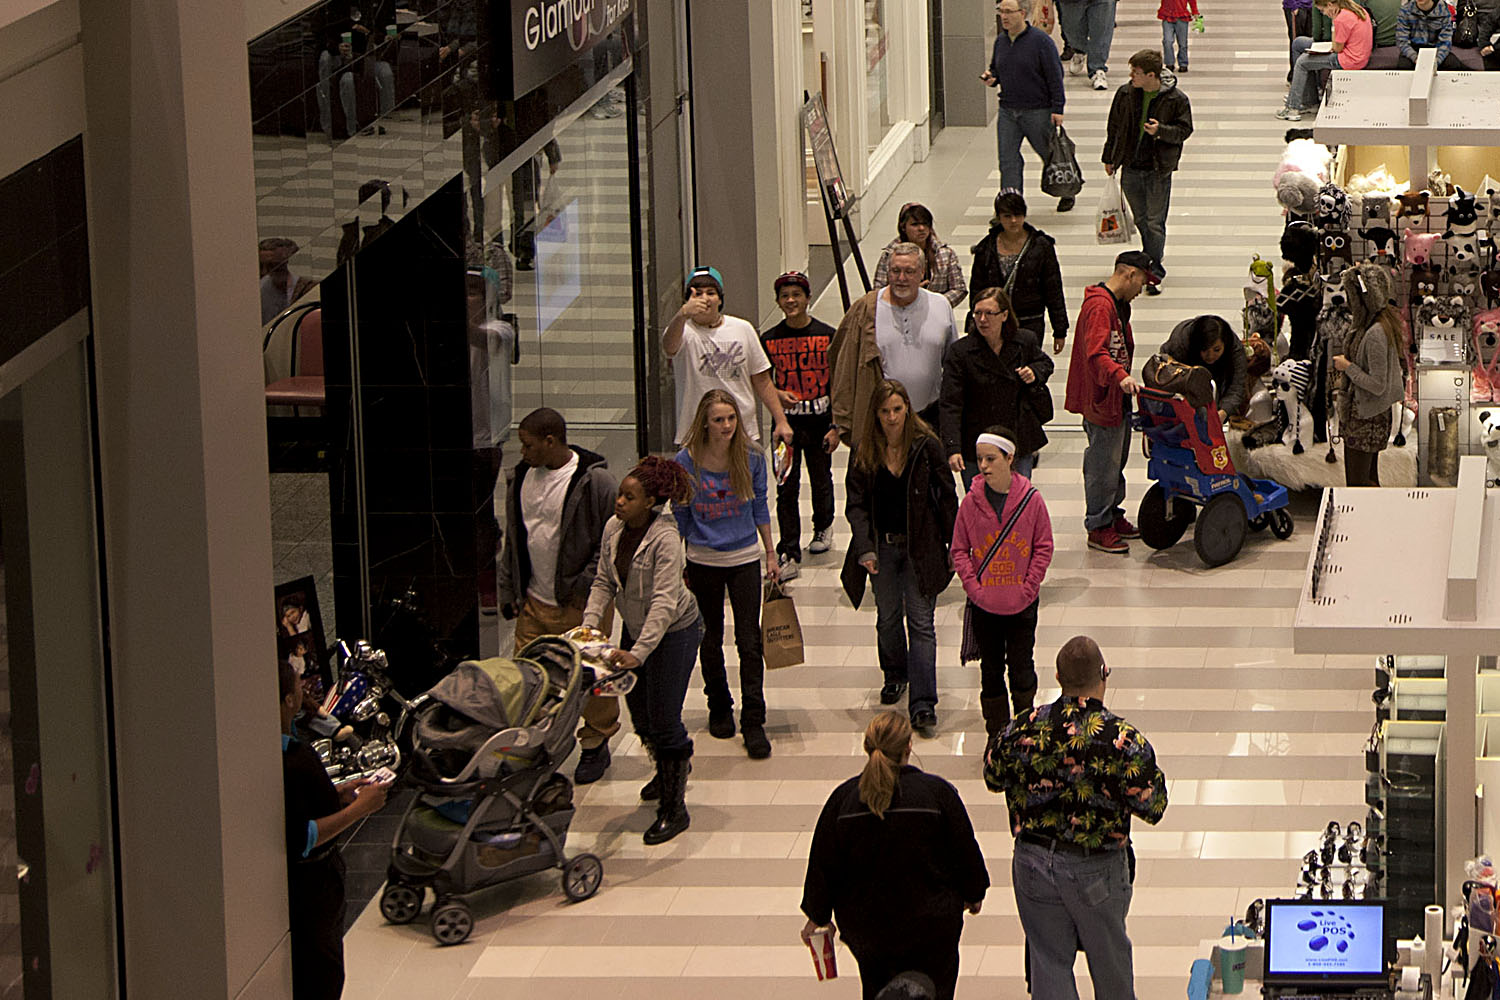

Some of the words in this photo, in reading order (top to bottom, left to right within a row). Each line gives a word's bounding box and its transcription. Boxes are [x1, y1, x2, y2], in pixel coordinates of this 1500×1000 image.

[765, 336, 830, 354] WHENEVER
[1429, 333, 1457, 342] SALE
[798, 351, 830, 370] CALL
[812, 395, 830, 414] UP
[1322, 927, 1347, 935] POS
